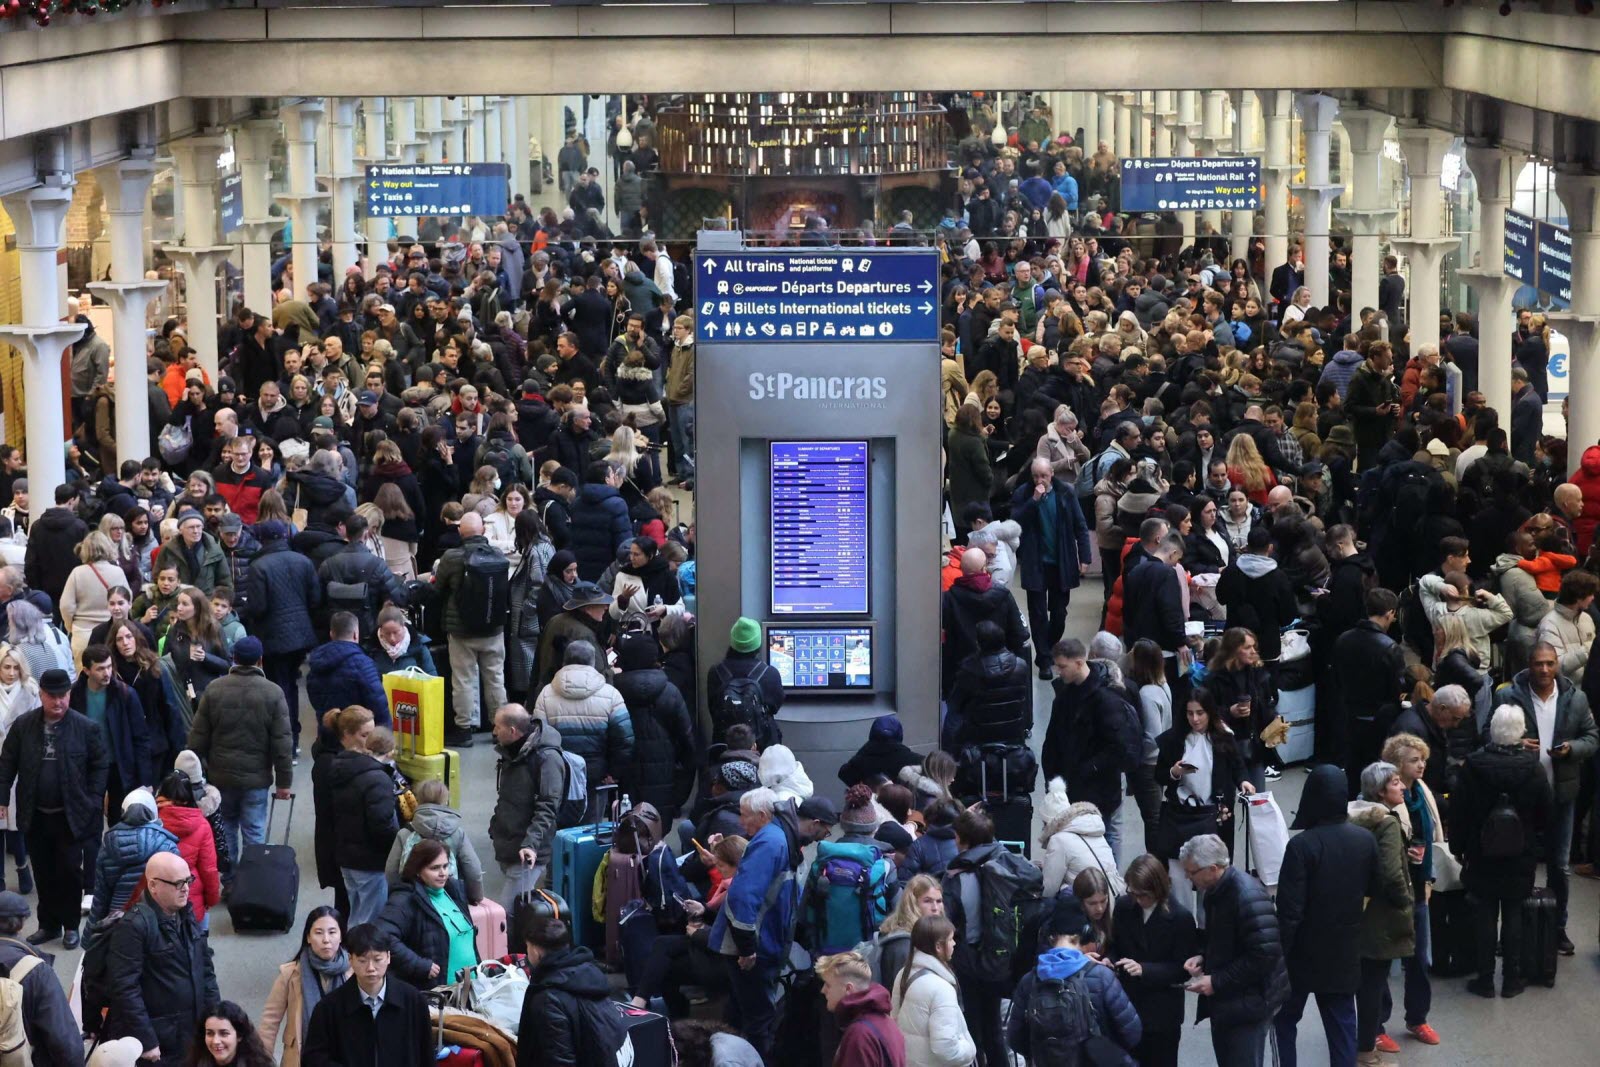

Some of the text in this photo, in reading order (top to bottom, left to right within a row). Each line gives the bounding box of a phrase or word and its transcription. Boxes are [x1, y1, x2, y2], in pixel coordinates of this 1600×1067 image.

[1171, 160, 1200, 169] Départs
[1202, 160, 1244, 169] Departures
[382, 166, 430, 175] National Rail
[383, 181, 399, 190] Way
[1216, 187, 1230, 195] Way
[725, 260, 785, 272] All trains
[782, 280, 833, 296] Départs
[837, 282, 911, 296] Departures
[734, 302, 911, 314] Billets International tickets
